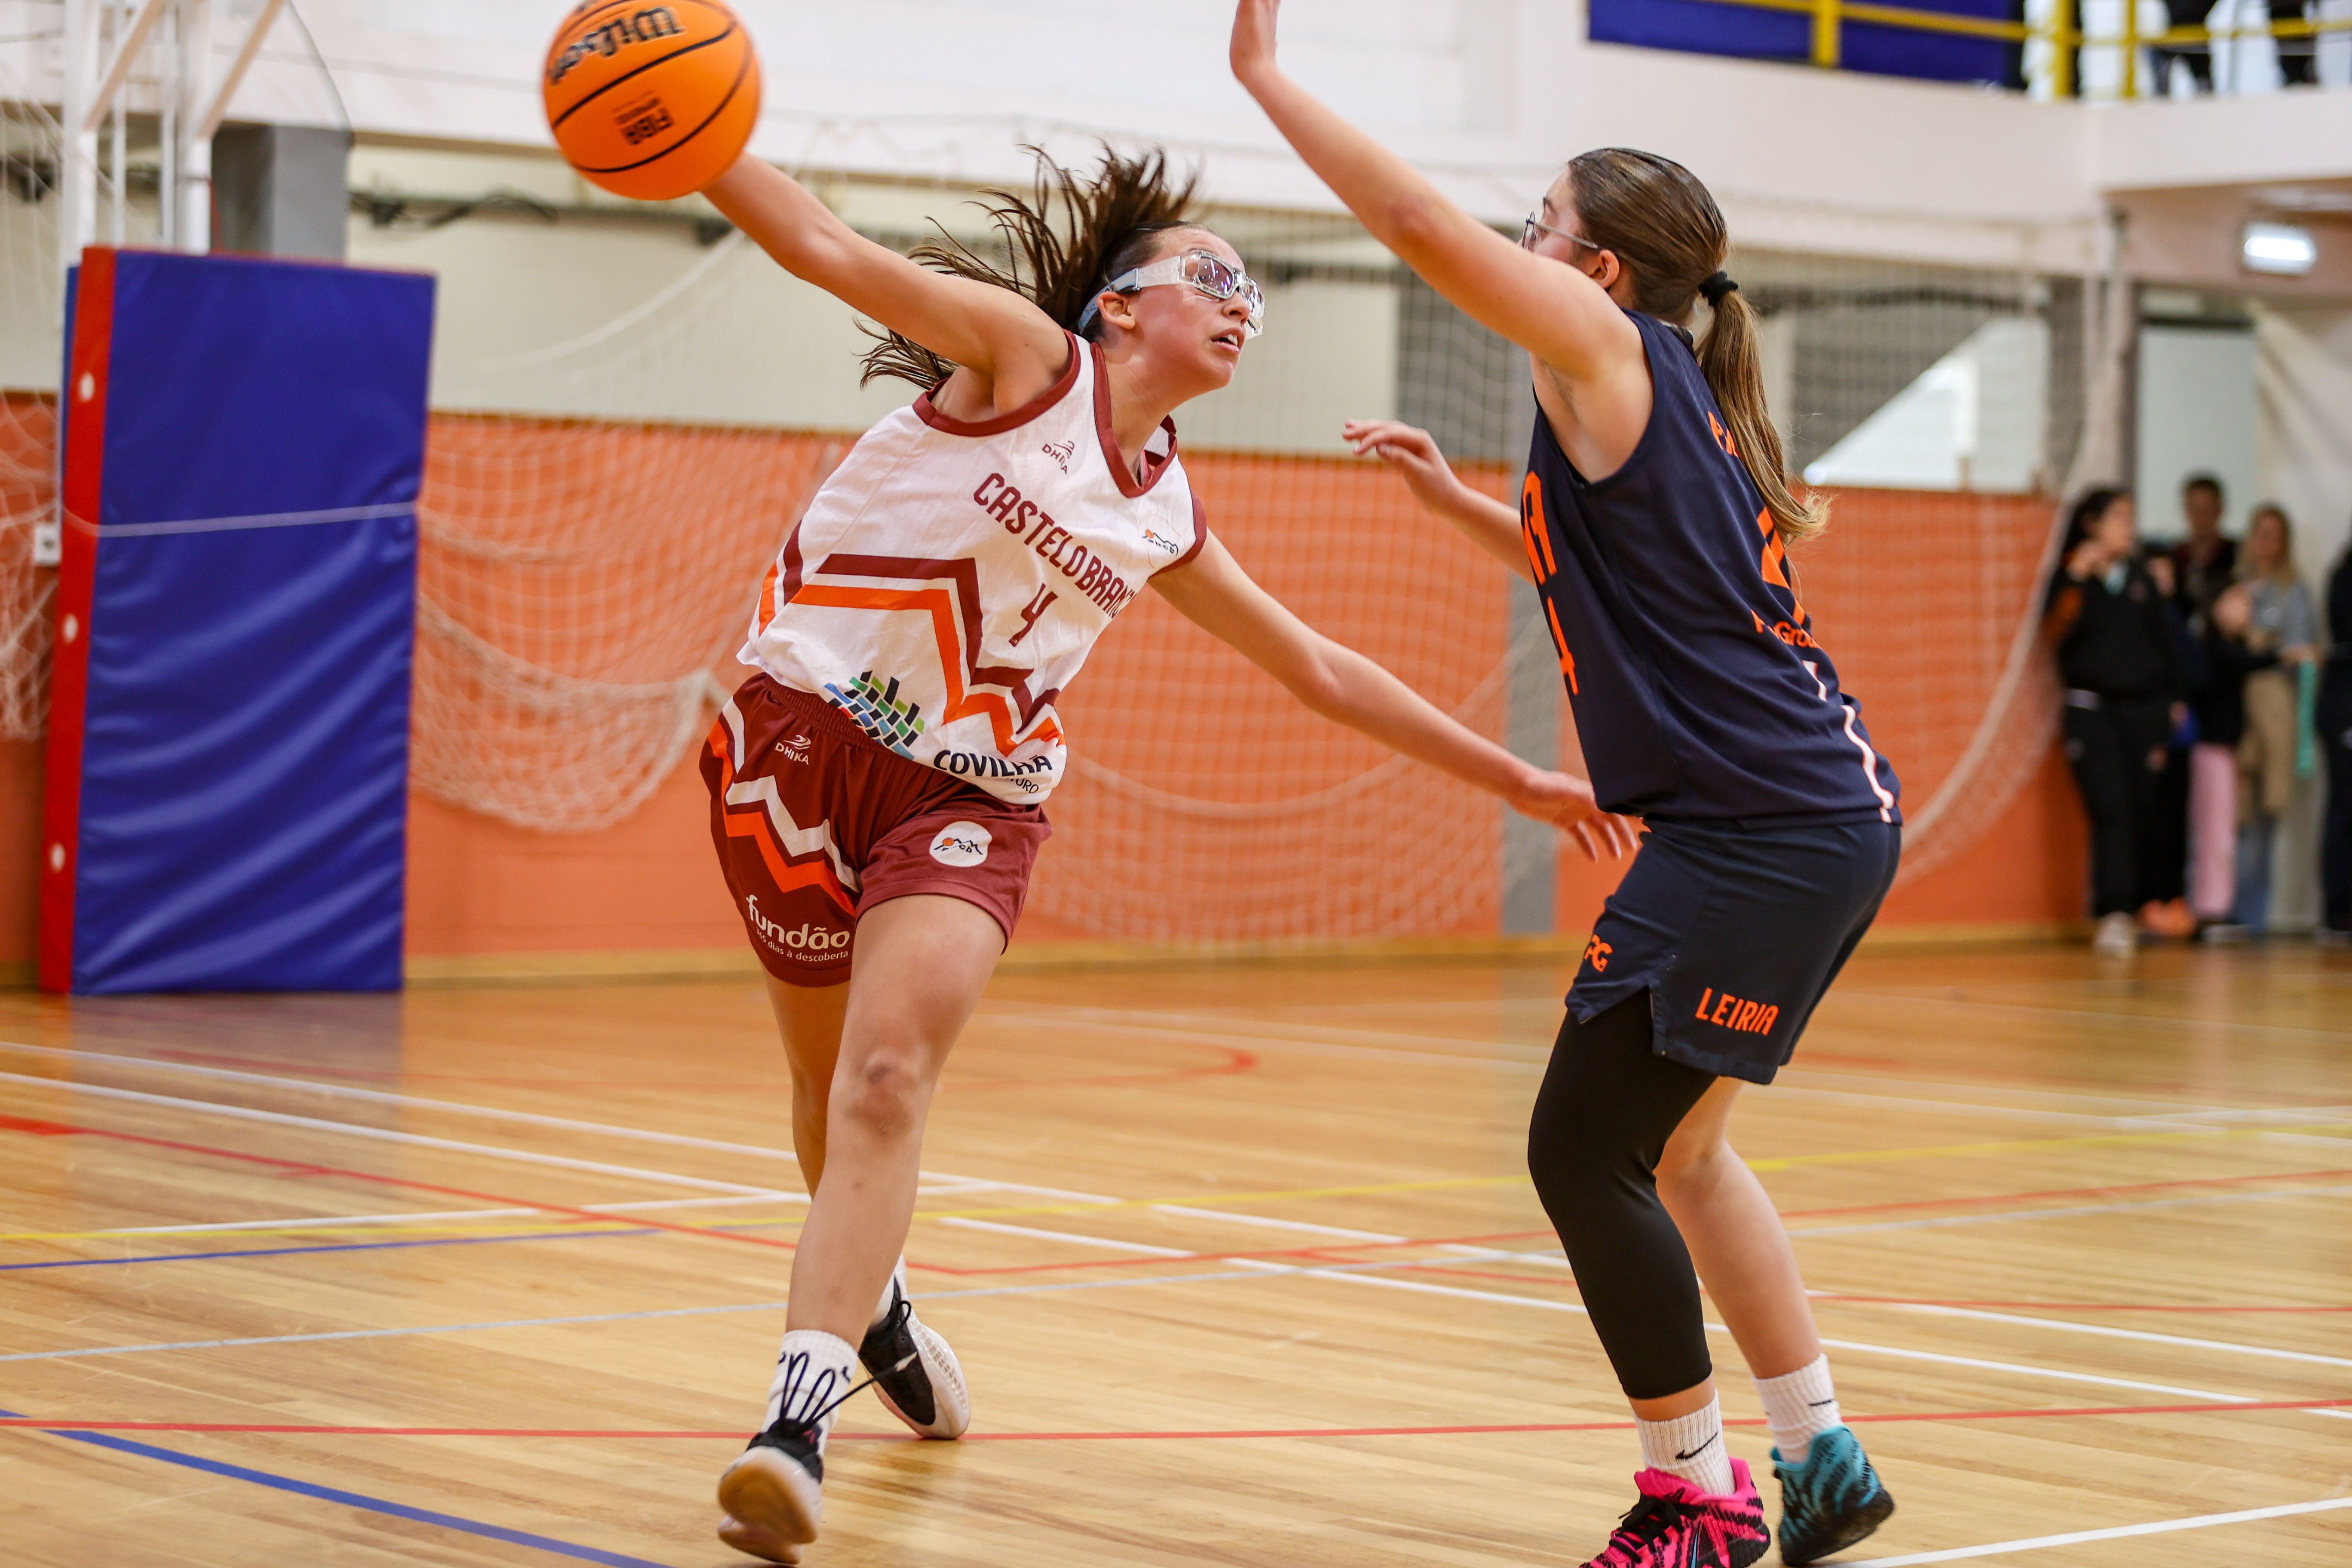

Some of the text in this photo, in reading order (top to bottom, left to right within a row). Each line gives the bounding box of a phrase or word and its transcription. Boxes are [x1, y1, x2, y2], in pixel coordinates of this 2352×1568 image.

[1008, 582, 1059, 648] 4
[775, 741, 809, 766] DHIKA
[933, 749, 1053, 777] COVILHÃ
[746, 894, 850, 950] fundão
[768, 940, 784, 955] dias
[787, 949, 793, 958] à
[796, 950, 848, 962] descoberta
[1694, 987, 1779, 1036] LEIRIA
